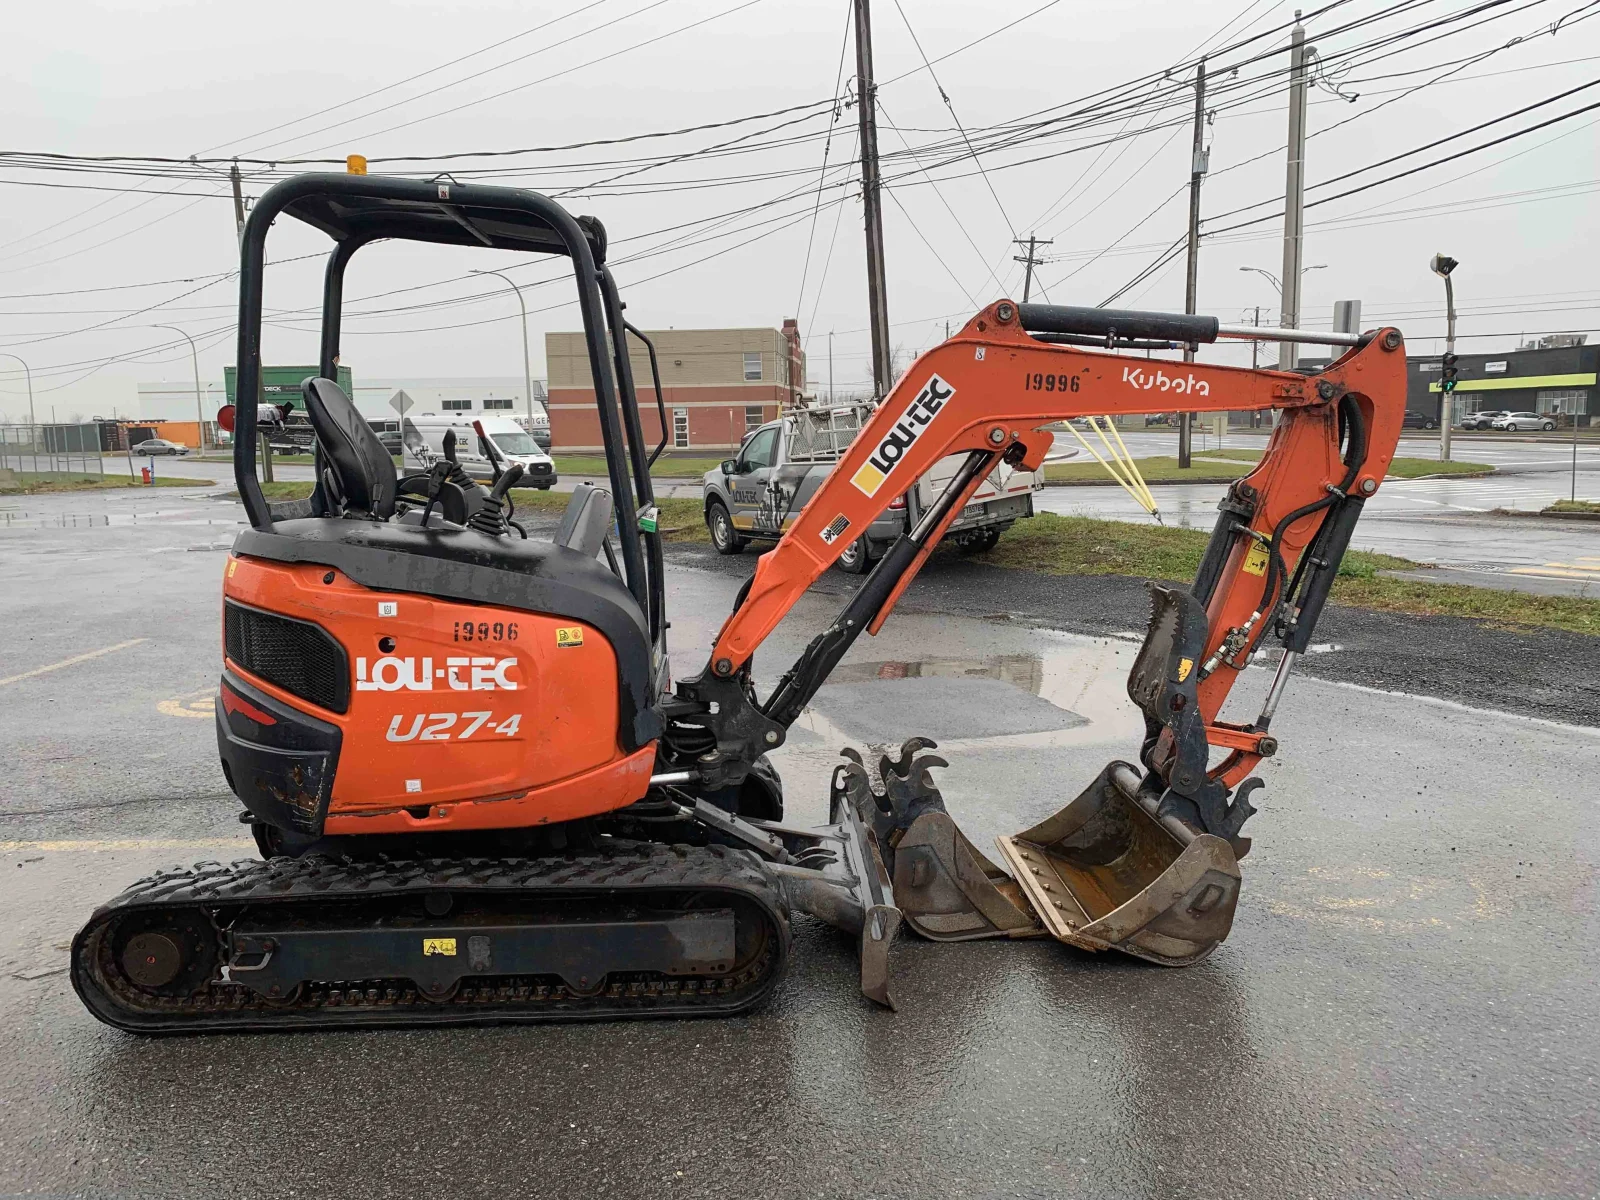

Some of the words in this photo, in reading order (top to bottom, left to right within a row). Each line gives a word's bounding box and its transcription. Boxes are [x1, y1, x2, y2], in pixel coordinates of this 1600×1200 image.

[1025, 373, 1081, 393] 19996
[1122, 366, 1210, 396] Kubota
[869, 378, 953, 475] LOU-TEC
[453, 621, 519, 642] 19996
[356, 656, 518, 692] LOU-TEC
[385, 710, 523, 742] U27-4
